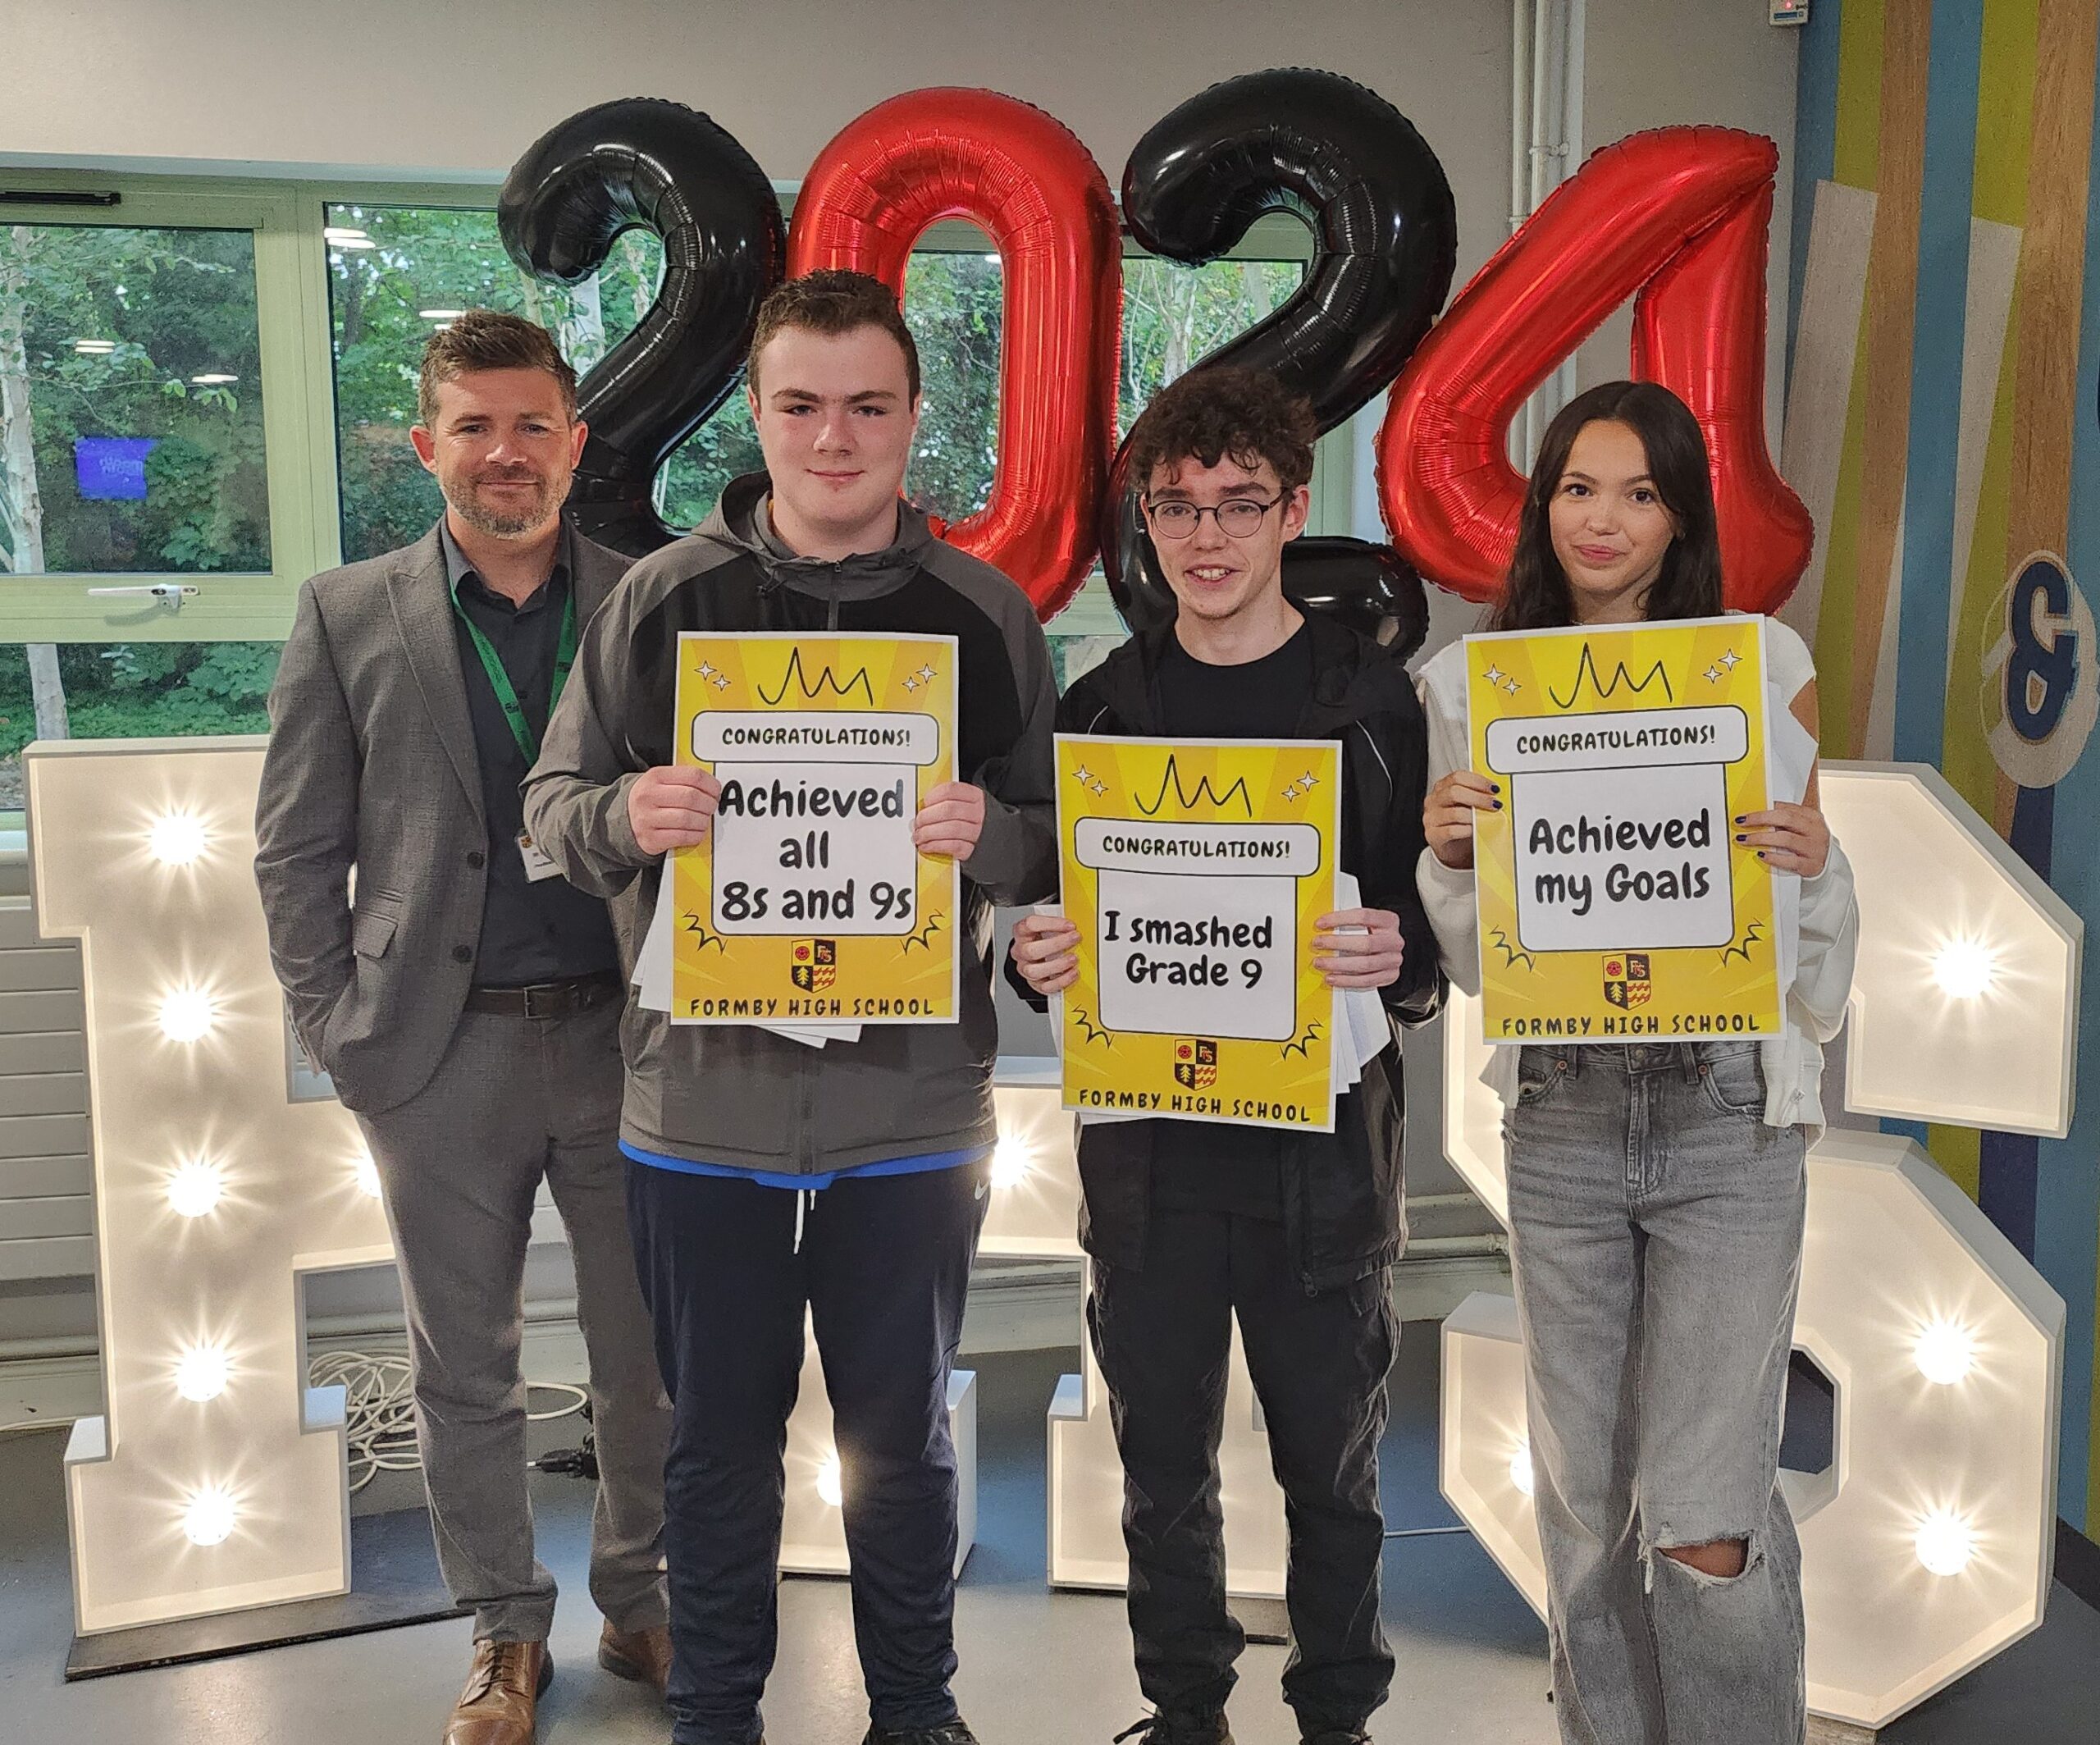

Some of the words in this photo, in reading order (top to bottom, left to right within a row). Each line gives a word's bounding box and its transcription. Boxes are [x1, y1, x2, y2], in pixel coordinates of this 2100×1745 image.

[722, 728, 910, 746] CONGRATULATIONS!
[1516, 724, 1715, 755] CONGRATULATIONS!
[719, 779, 903, 818] Achieved
[1102, 835, 1290, 858] CONGRATULATIONS!
[1529, 807, 1710, 855] Achieved
[779, 830, 829, 870] all
[721, 881, 769, 921] 8s
[781, 878, 855, 920] and
[870, 881, 912, 920] 9s
[1535, 874, 1592, 916] my
[1605, 861, 1710, 902] Goals
[1104, 910, 1121, 942] I
[1129, 915, 1272, 949] smashed
[1125, 952, 1230, 987] Grade
[1240, 958, 1262, 989] 9
[691, 998, 778, 1016] FORMBY
[788, 998, 841, 1016] HIGH
[853, 998, 934, 1016] SCHOOL
[1502, 1016, 1591, 1036] FORMBY
[1604, 1016, 1659, 1035] HIGH
[1672, 1014, 1760, 1034] SCHOOL
[1080, 1089, 1161, 1110] FORMBY
[1171, 1094, 1221, 1115] HIGH
[1231, 1099, 1312, 1123] SCHOOL
